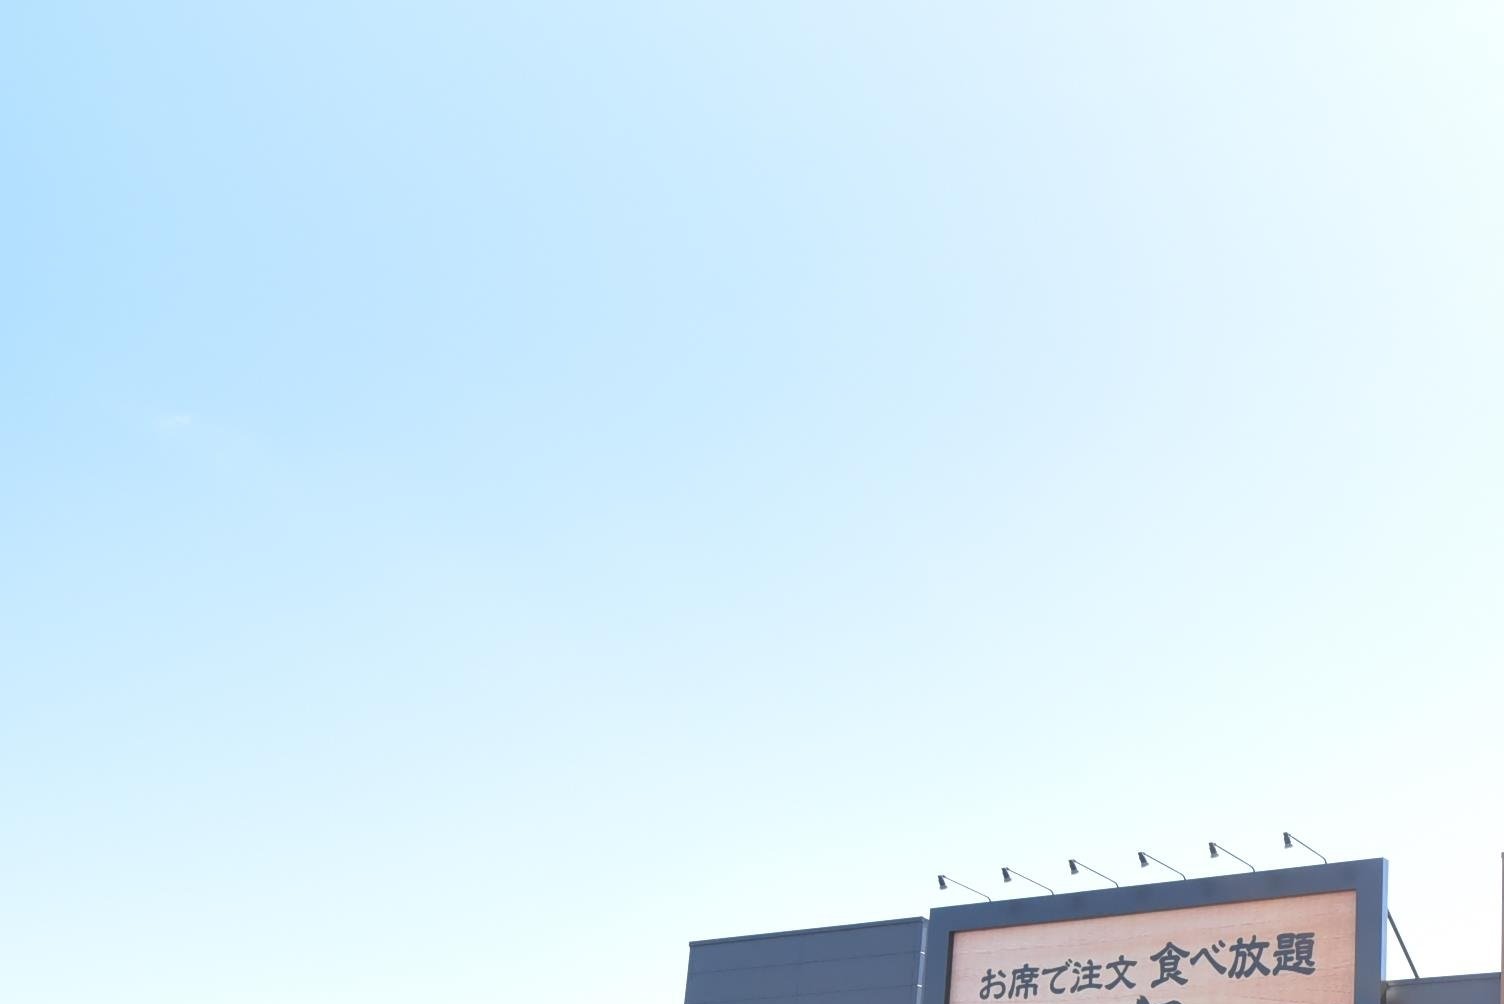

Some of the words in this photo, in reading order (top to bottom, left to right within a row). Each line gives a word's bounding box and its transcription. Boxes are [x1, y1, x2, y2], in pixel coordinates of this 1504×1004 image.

[979, 955, 1138, 1000] お席で注文
[1149, 932, 1316, 988] 食べ放題
